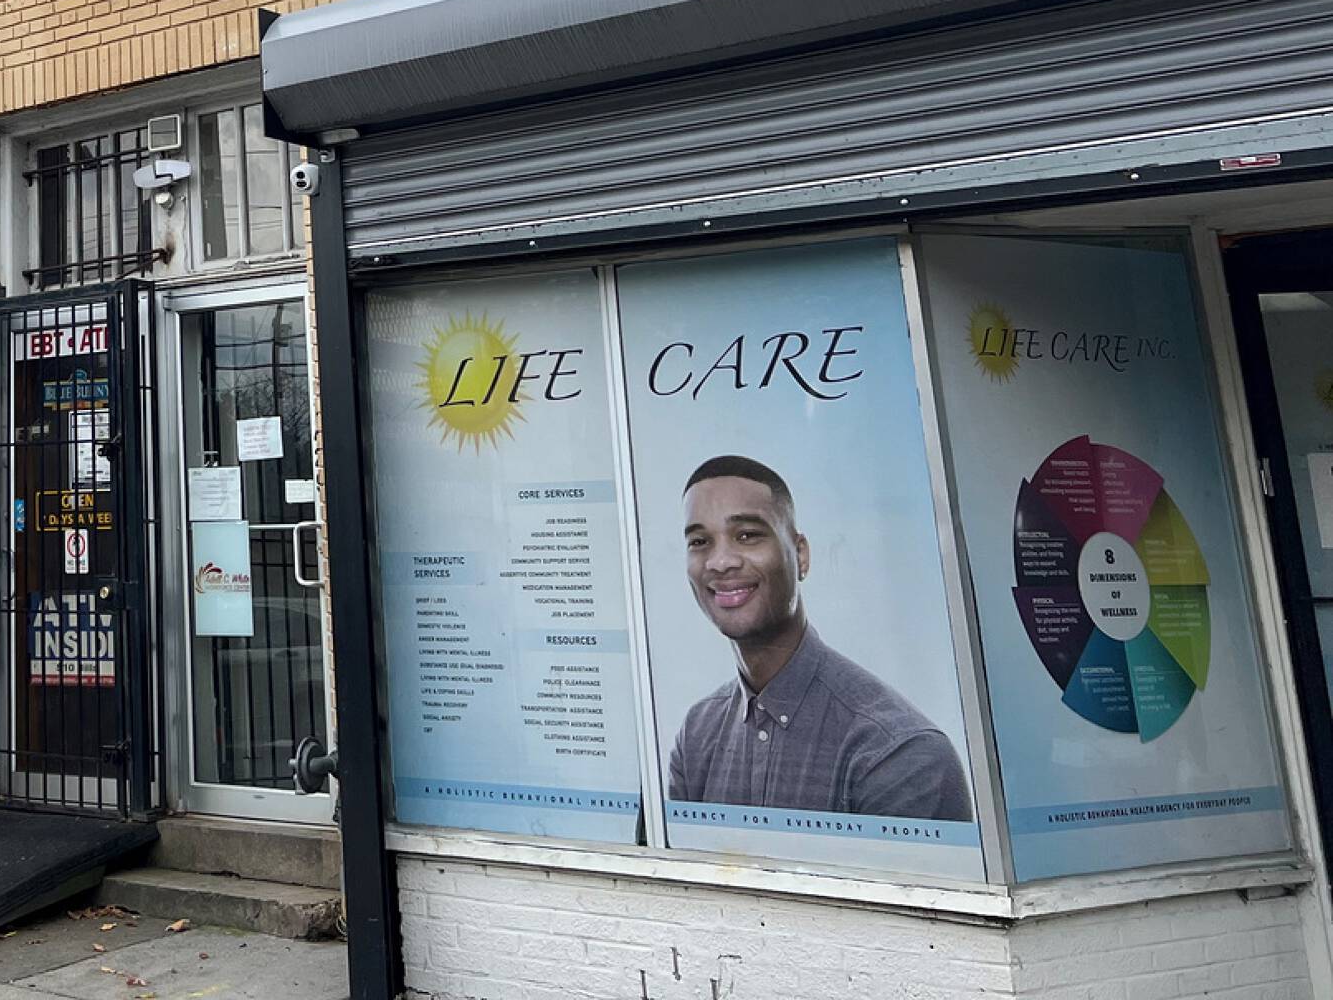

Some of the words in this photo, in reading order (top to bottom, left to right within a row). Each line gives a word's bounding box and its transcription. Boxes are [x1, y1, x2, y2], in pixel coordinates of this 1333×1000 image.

[30, 331, 64, 356] EBT
[978, 326, 1043, 360] LIFE
[1051, 330, 1131, 373] CARE
[1137, 336, 1176, 360] INC.
[439, 348, 584, 408] LIFE
[648, 326, 865, 401] CARE
[518, 490, 541, 500] CORE
[544, 488, 586, 499] SERVICES
[89, 511, 112, 525] WEE
[413, 555, 465, 566] THERAPEUTIC
[1104, 548, 1116, 565] 8
[413, 568, 451, 578] SERVICES
[1089, 572, 1138, 583] DIMENSIONS
[1111, 590, 1121, 600] OF
[1100, 607, 1139, 617] WELLNESS
[546, 635, 597, 646] RESOURCES
[438, 786, 495, 799] HOLISTIC
[502, 791, 582, 806] BEHAVIORAL
[590, 799, 640, 809] HEALTH
[1055, 811, 1087, 823] HOLISTIC
[1087, 807, 1129, 820] BEHAVIORAL
[1129, 805, 1154, 816] HEALTH
[1155, 802, 1180, 813] AGENCY
[672, 809, 727, 822] AGENCY
[743, 813, 770, 825] FOR
[787, 817, 864, 833] EVERYDAY
[881, 825, 942, 839] PEOPLE
